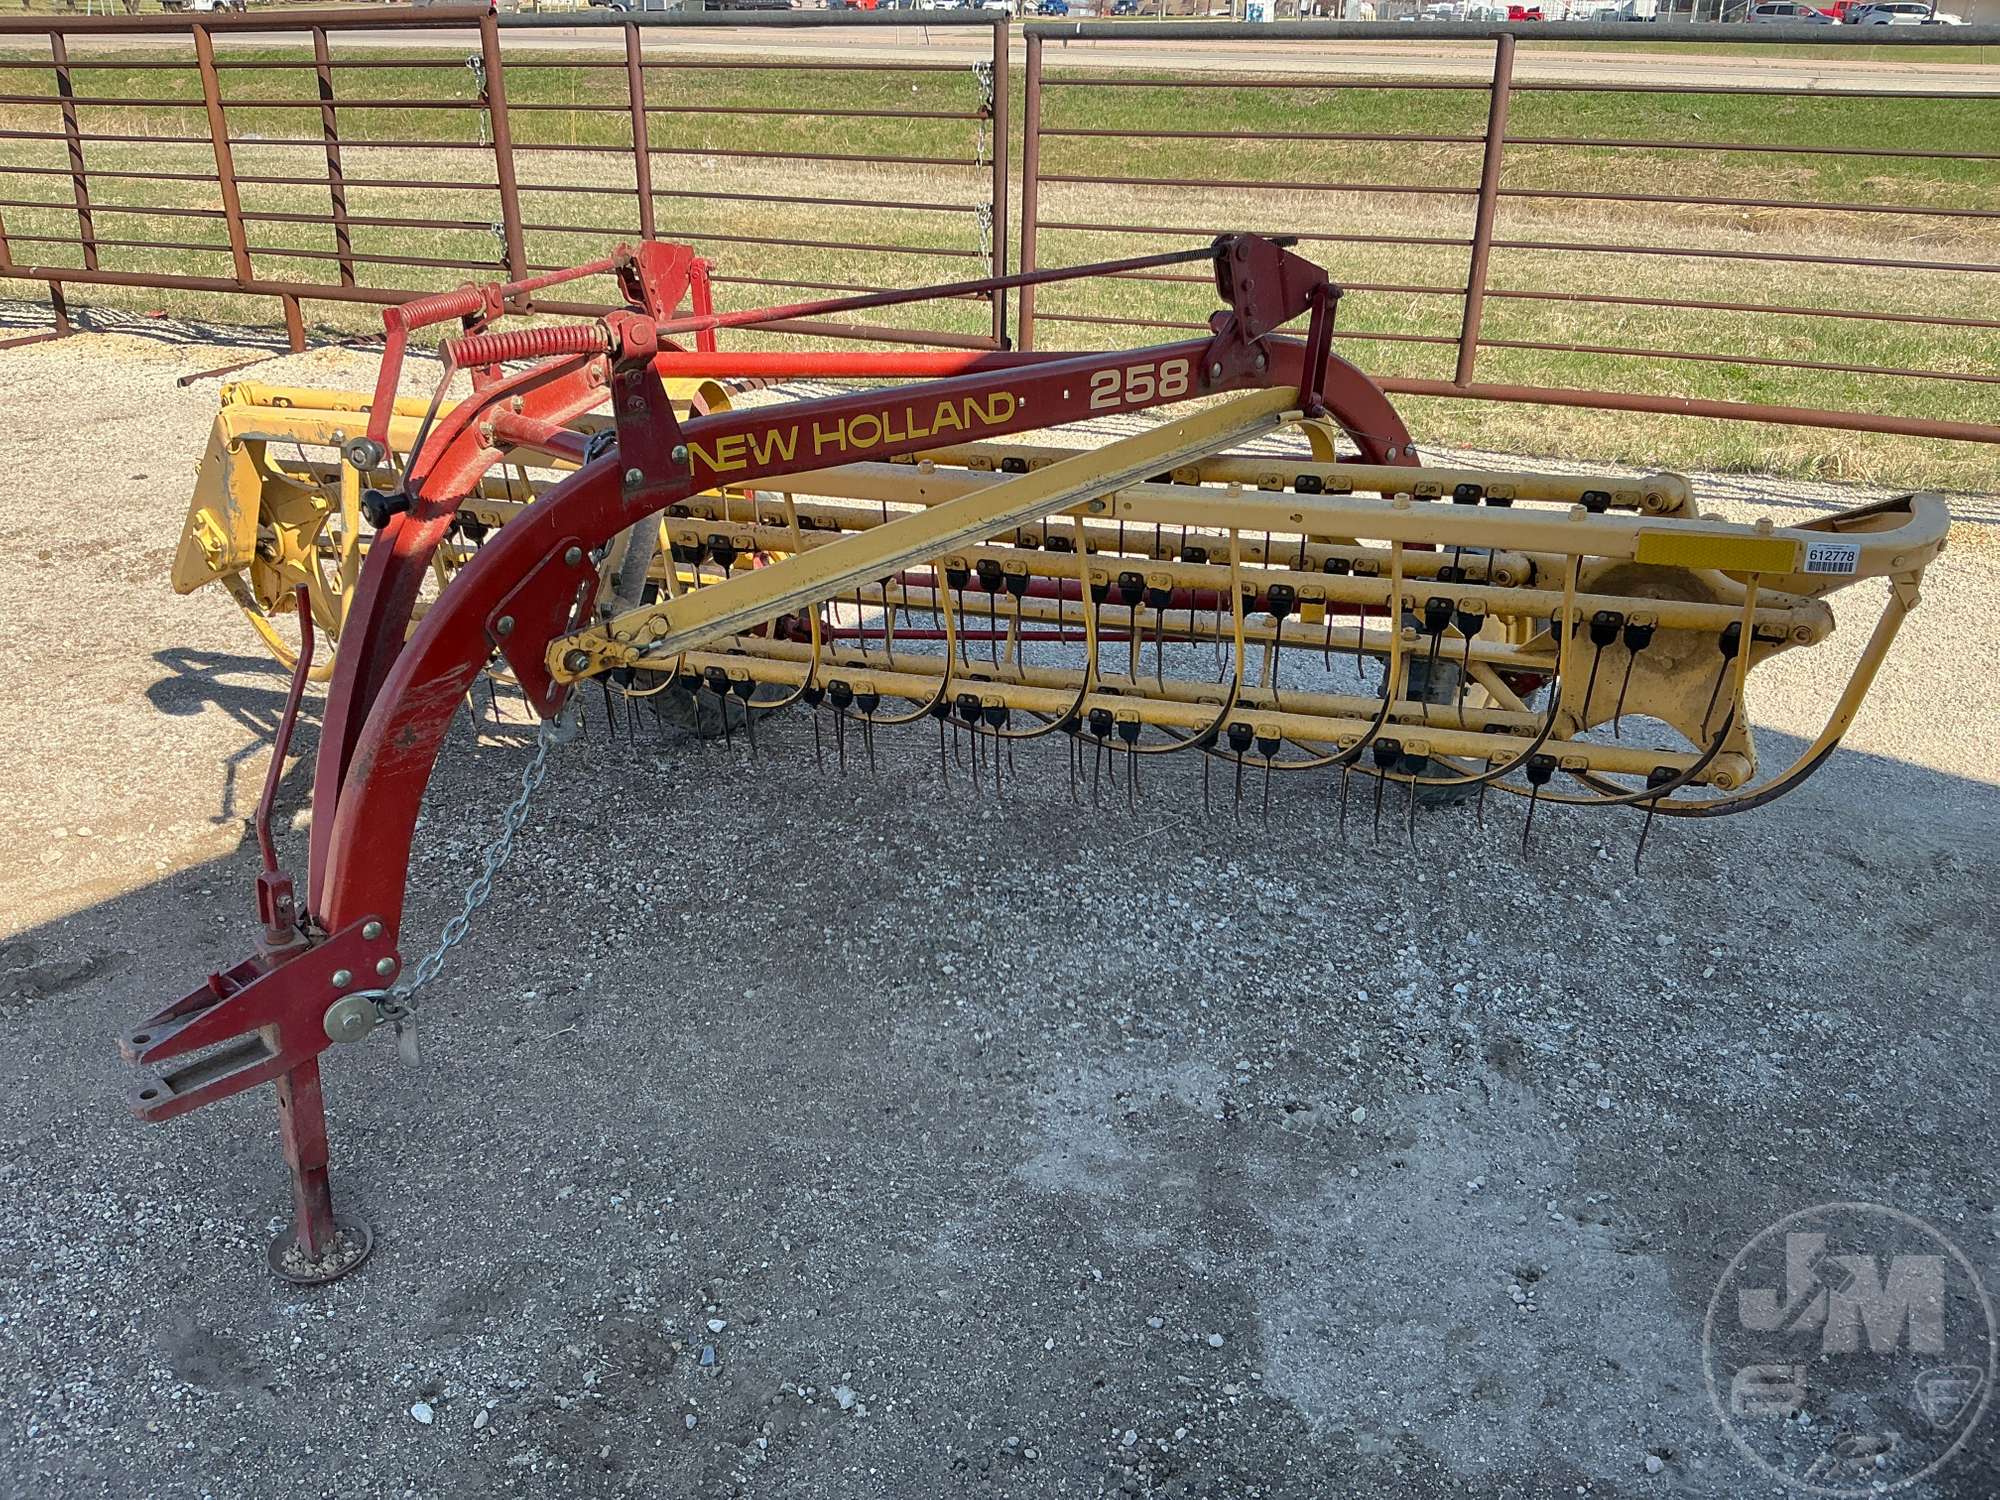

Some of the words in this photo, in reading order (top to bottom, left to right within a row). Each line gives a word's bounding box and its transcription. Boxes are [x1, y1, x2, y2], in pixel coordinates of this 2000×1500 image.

[687, 426, 798, 476] NEW
[814, 391, 1015, 455] HOLLAND
[1090, 359, 1189, 410] 258
[1810, 549, 1855, 562] 612778
